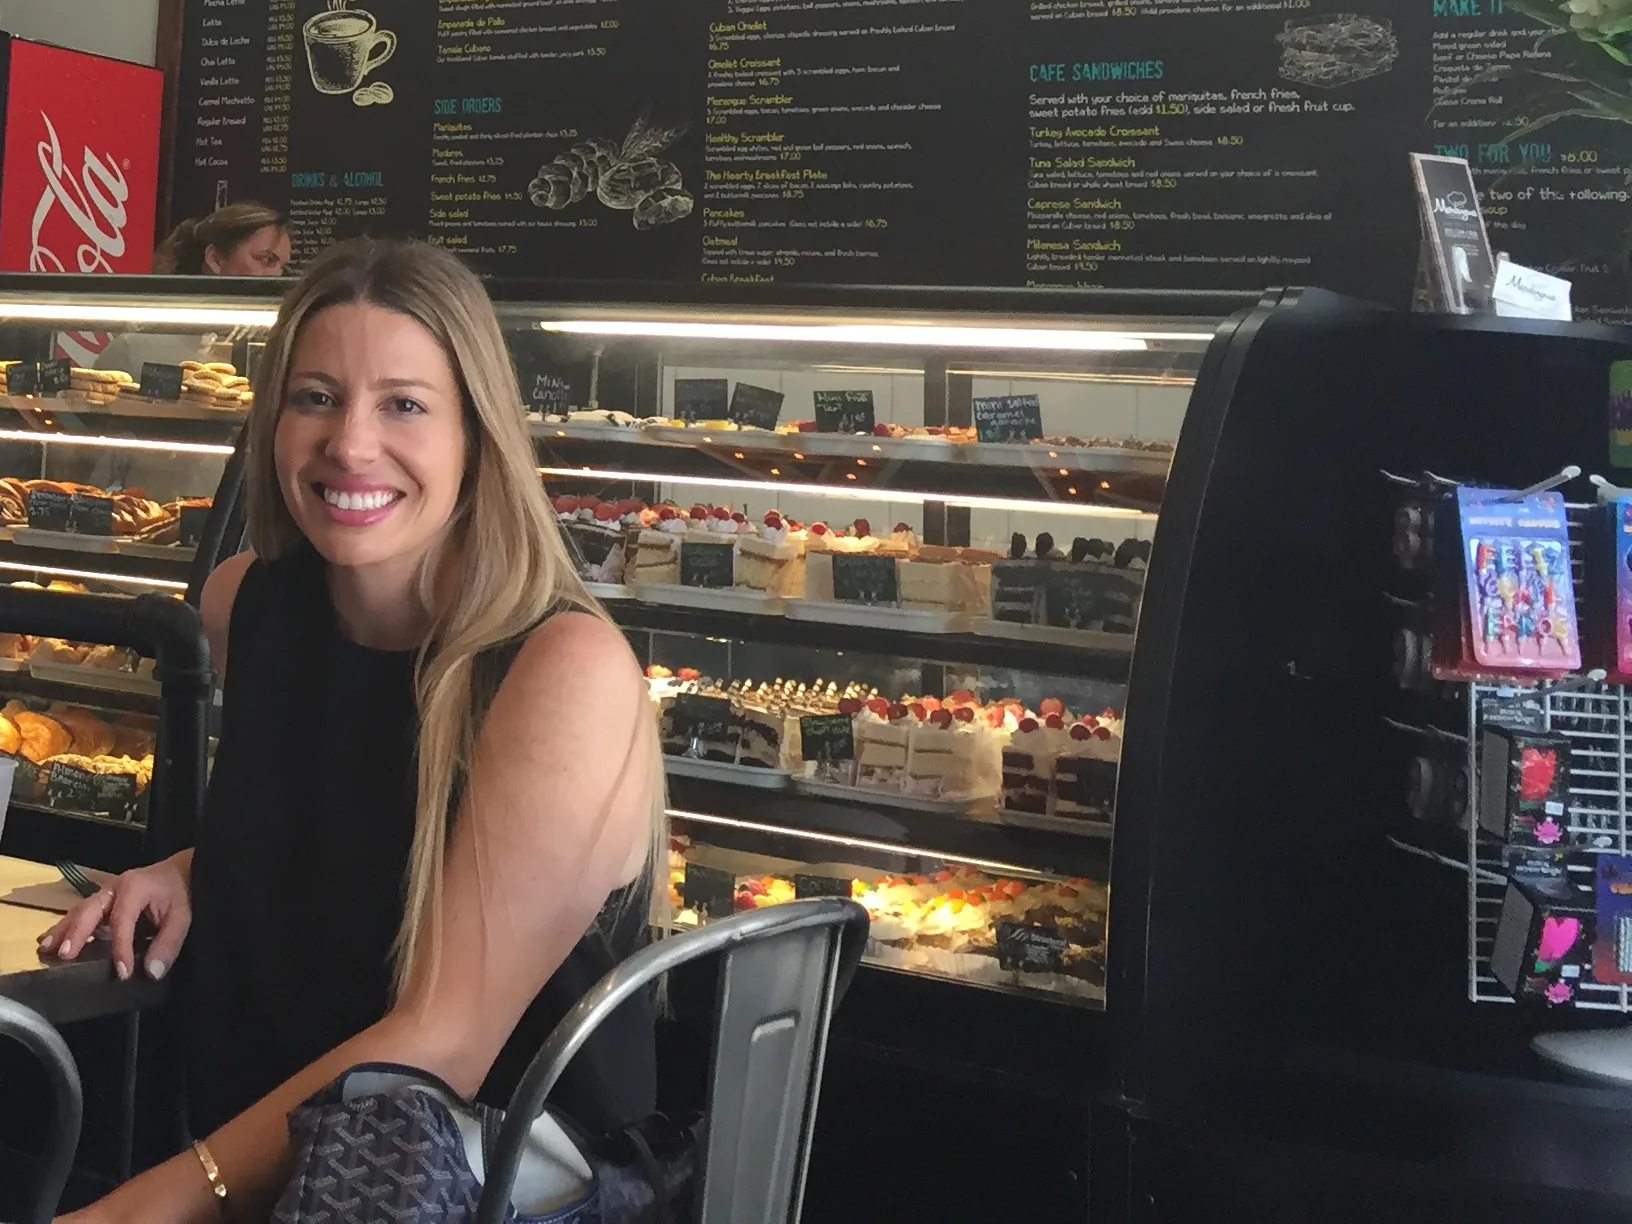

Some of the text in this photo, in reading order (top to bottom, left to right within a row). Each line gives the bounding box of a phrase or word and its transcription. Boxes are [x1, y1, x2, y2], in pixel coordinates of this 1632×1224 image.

[1030, 61, 1163, 82] CAFE SANDWICHES
[1029, 94, 1065, 105] Served
[1067, 93, 1088, 104] with
[1091, 96, 1112, 105] your
[1115, 92, 1149, 103] choice
[1152, 91, 1166, 102] of
[1230, 89, 1267, 100] french
[1270, 88, 1301, 99] fries,
[434, 98, 501, 114] SIDE ORDERS
[1028, 108, 1058, 117] sweet
[1061, 106, 1098, 117] potato
[1100, 106, 1126, 116] fries
[1193, 104, 1216, 114] side
[1219, 103, 1250, 113] salad
[1252, 105, 1264, 113] or
[1268, 102, 1300, 112] fresh
[1304, 102, 1328, 111] fruit
[1332, 103, 1355, 112] cup.
